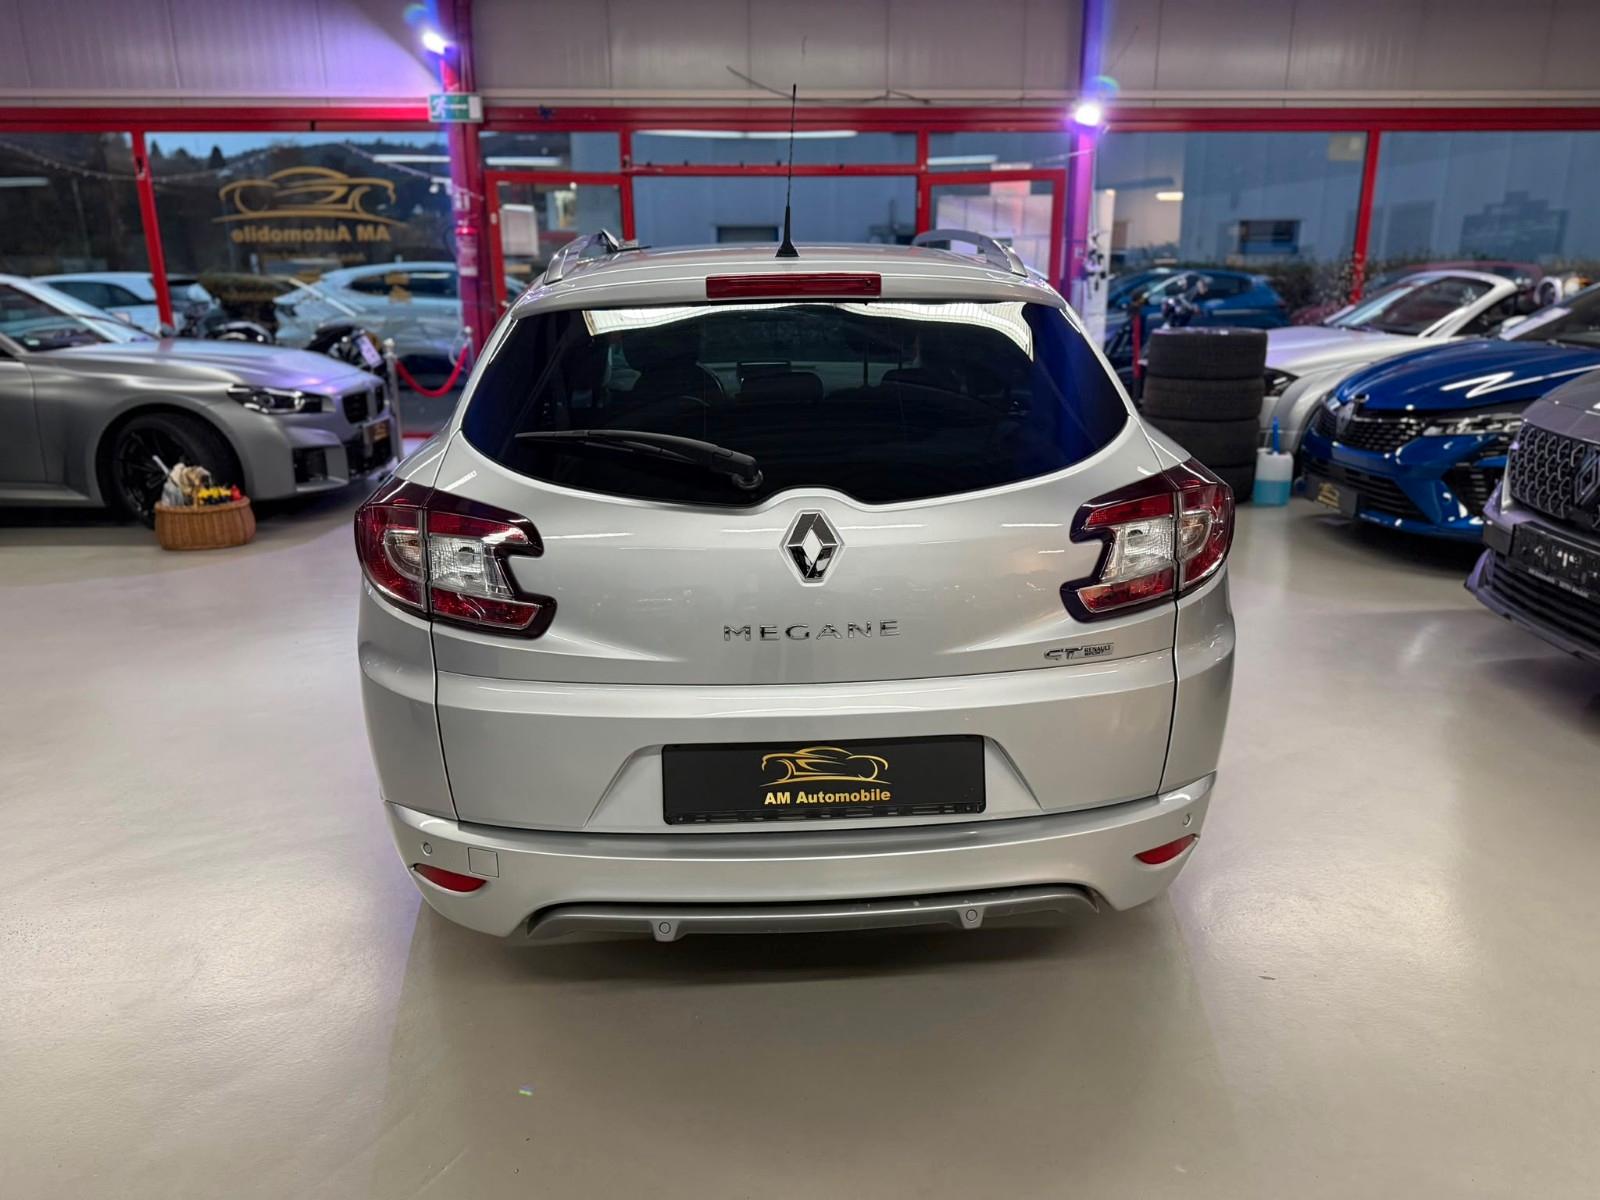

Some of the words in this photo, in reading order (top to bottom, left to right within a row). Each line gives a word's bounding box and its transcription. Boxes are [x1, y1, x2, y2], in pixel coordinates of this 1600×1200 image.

[723, 620, 900, 642] MEGANE
[764, 791, 791, 805] AM
[795, 789, 891, 804] Automobile
